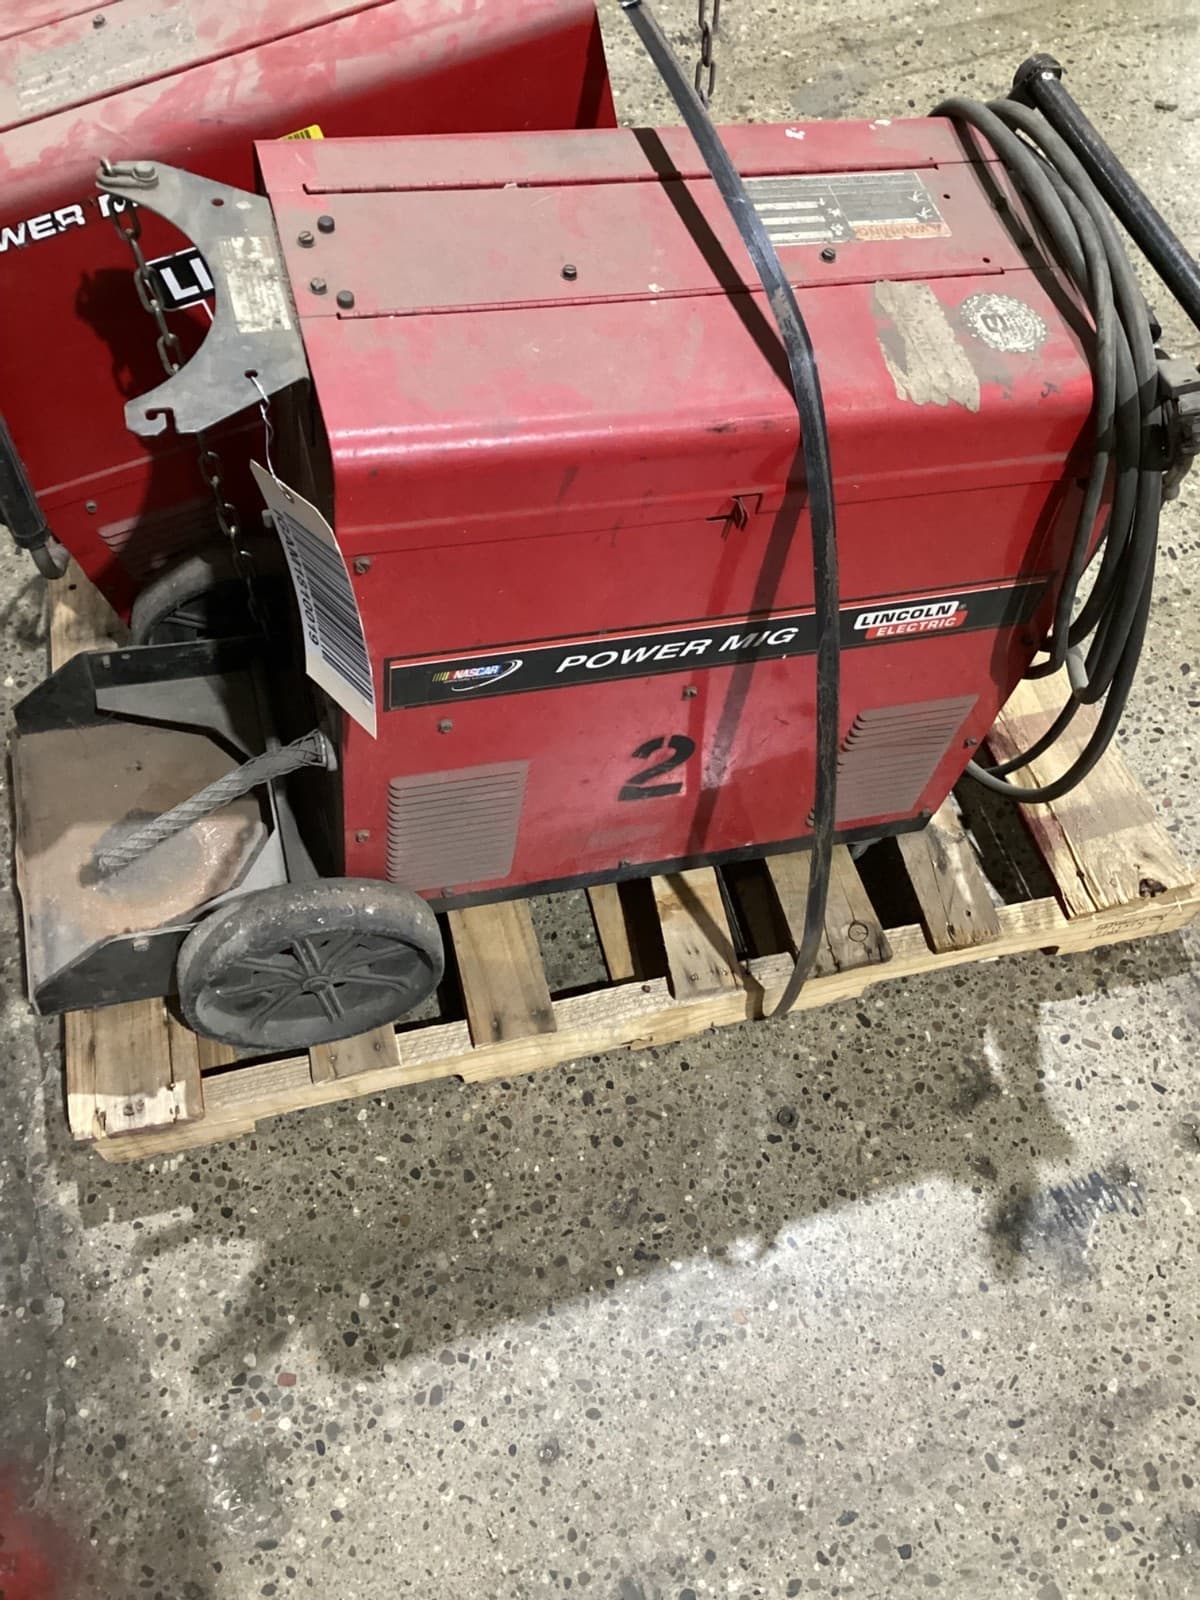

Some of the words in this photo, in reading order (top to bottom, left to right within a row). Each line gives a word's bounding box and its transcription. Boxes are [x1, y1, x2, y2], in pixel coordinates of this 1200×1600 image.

[860, 604, 953, 626] LINCOLN
[875, 617, 957, 637] ELECTRIC
[555, 638, 713, 673] POWER
[718, 627, 799, 652] MIG
[453, 665, 501, 679] NASCAR
[617, 734, 696, 802] 2
